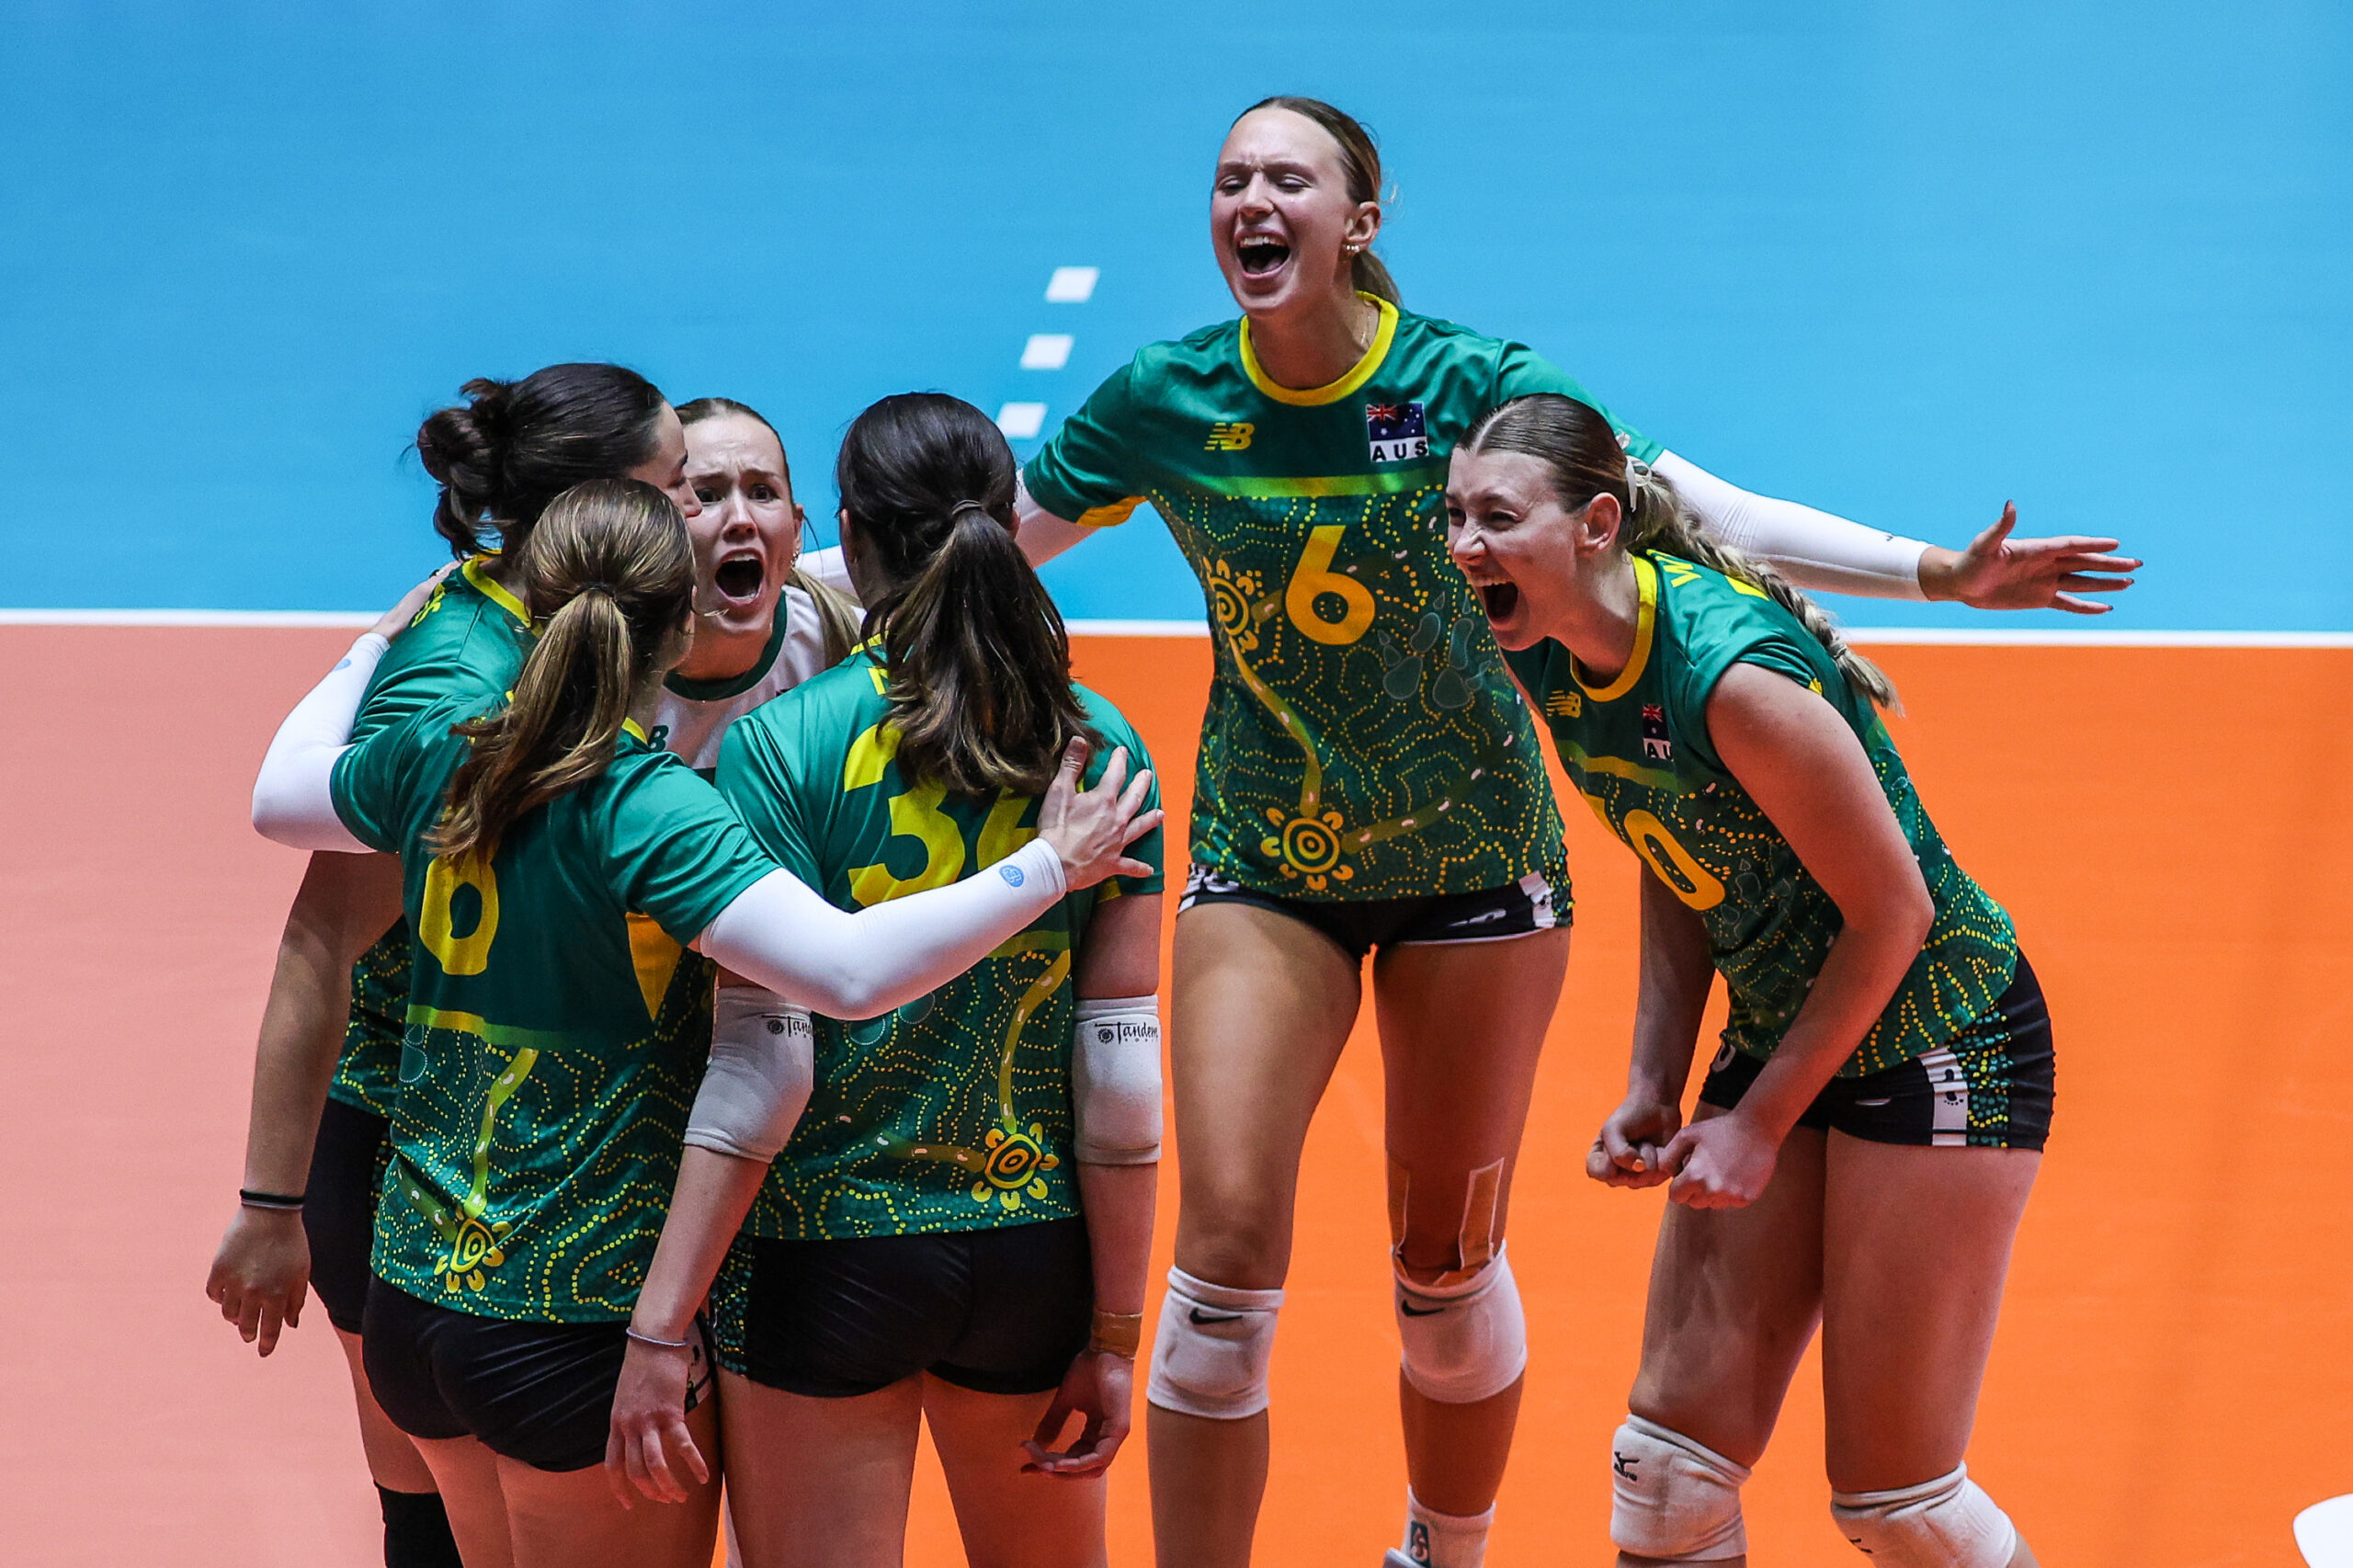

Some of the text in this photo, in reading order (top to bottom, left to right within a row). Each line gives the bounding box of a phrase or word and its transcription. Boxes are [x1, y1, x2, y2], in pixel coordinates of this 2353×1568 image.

[1203, 422, 1256, 450] NB
[1371, 440, 1429, 461] AUS
[1285, 525, 1376, 645] 6
